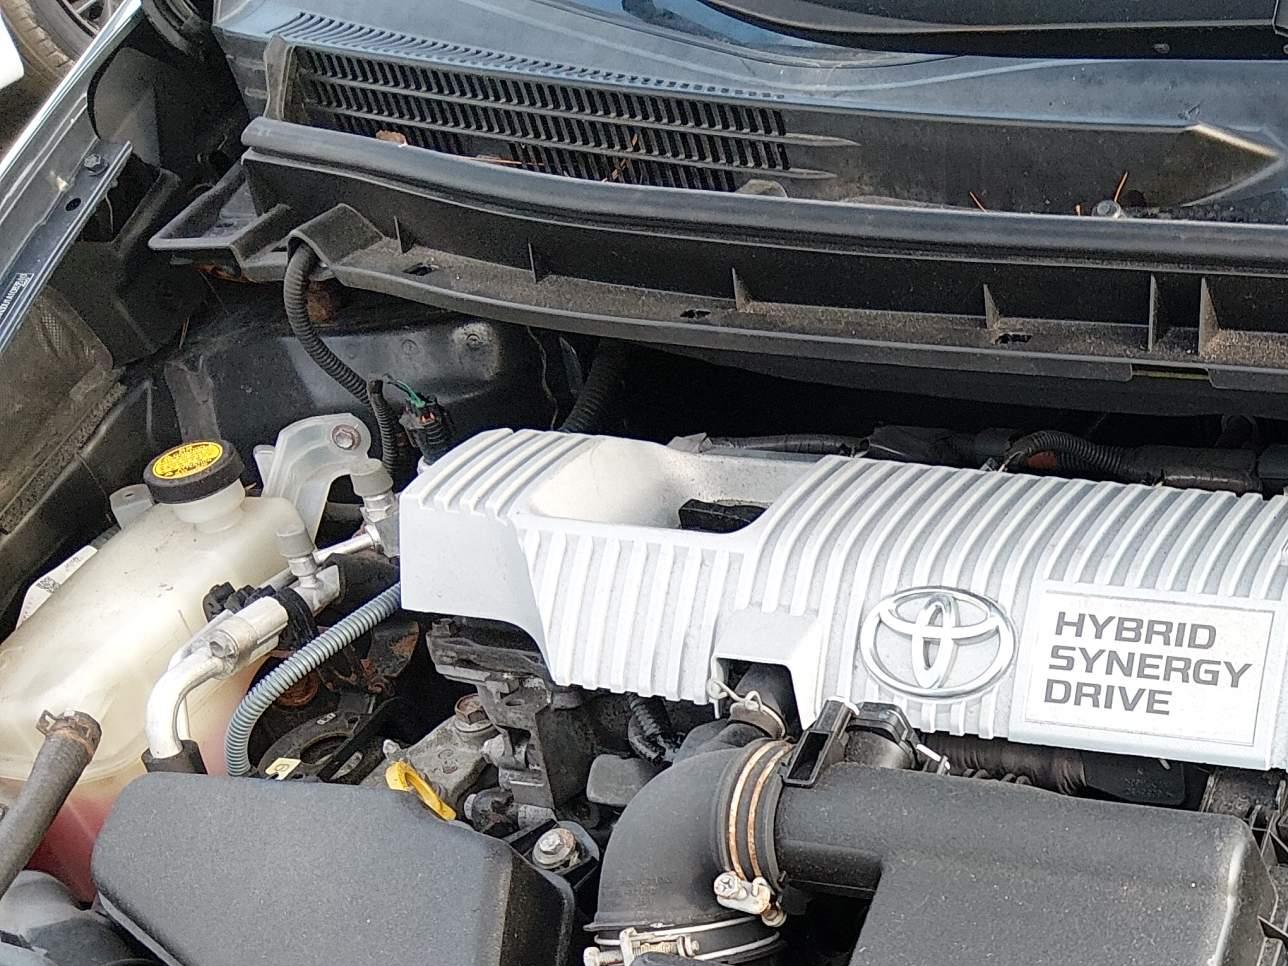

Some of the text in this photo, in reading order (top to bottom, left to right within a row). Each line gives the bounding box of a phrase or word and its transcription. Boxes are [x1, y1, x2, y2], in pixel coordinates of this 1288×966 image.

[1054, 611, 1217, 650] HYBRID
[1048, 644, 1253, 689] SYNERGY
[1044, 678, 1172, 715] DRIVE
